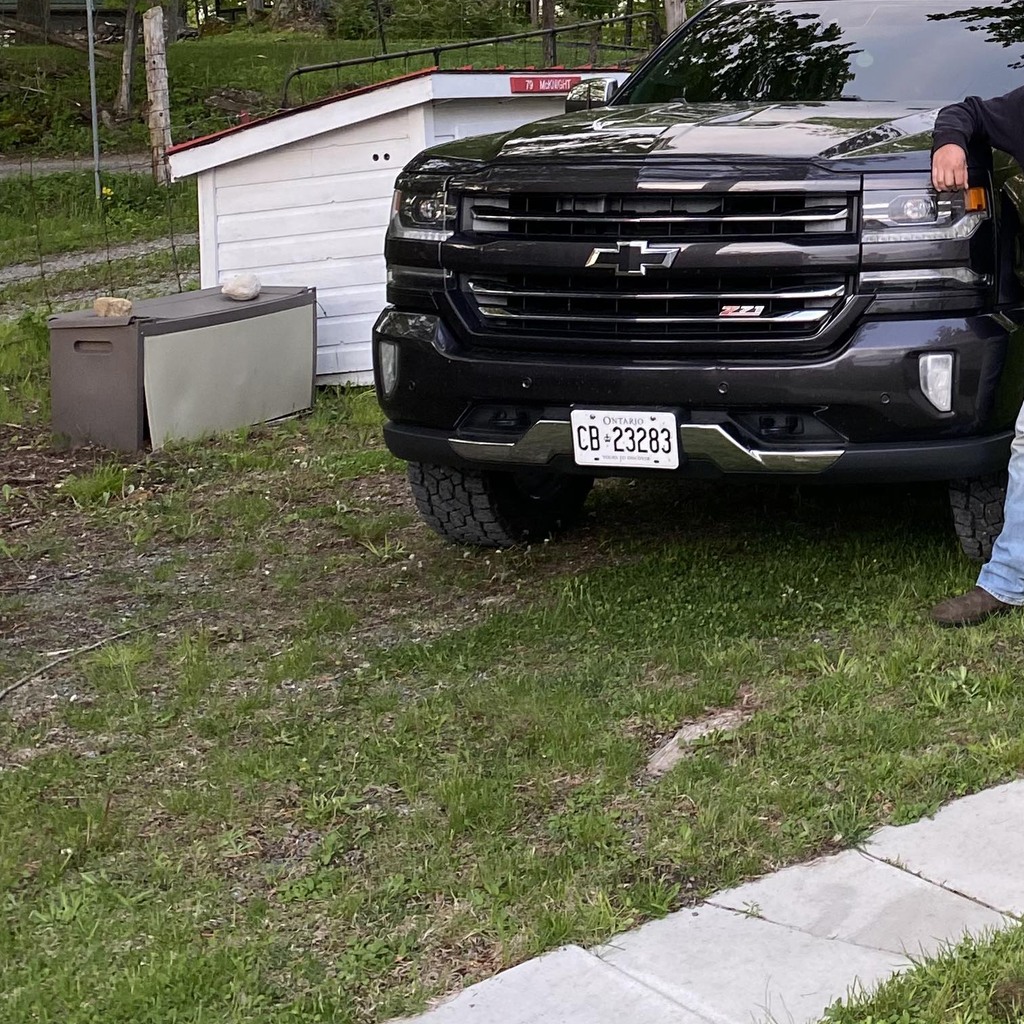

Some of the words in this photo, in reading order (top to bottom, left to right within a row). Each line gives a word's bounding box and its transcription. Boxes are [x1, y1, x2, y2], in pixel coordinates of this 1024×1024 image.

[525, 79, 534, 90] 79
[719, 305, 765, 316] Z71
[577, 425, 600, 451] CB
[612, 426, 671, 454] 23283
